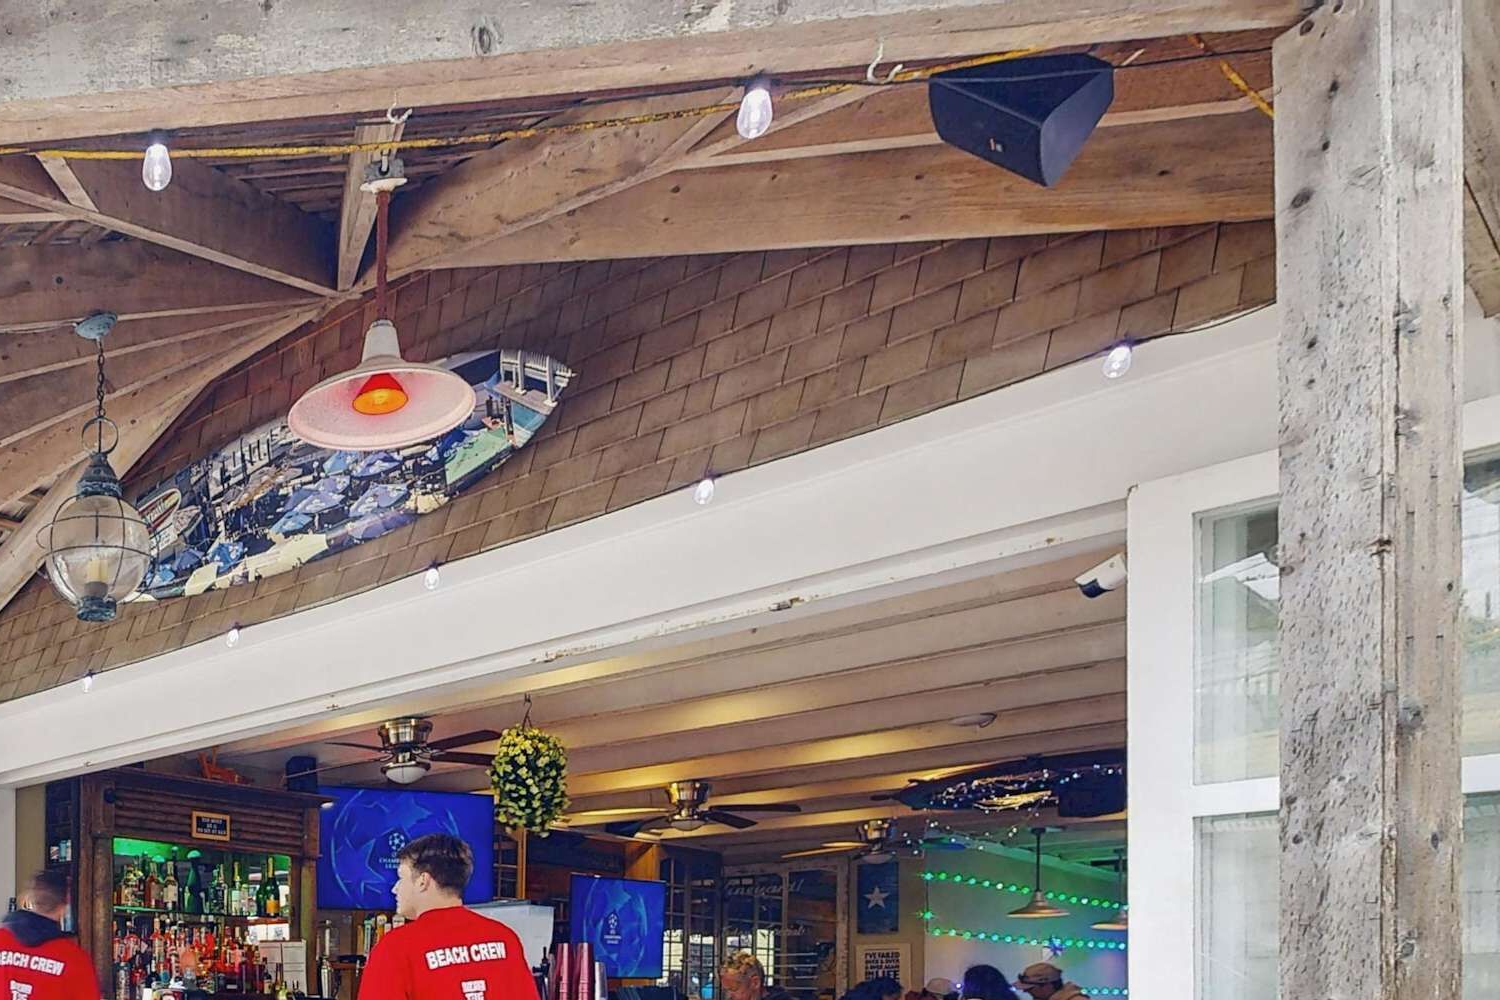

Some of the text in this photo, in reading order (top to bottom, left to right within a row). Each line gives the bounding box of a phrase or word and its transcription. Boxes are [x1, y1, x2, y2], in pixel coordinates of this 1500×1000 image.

[30, 956, 65, 976] CREW
[426, 942, 506, 970] BEACH CREW
